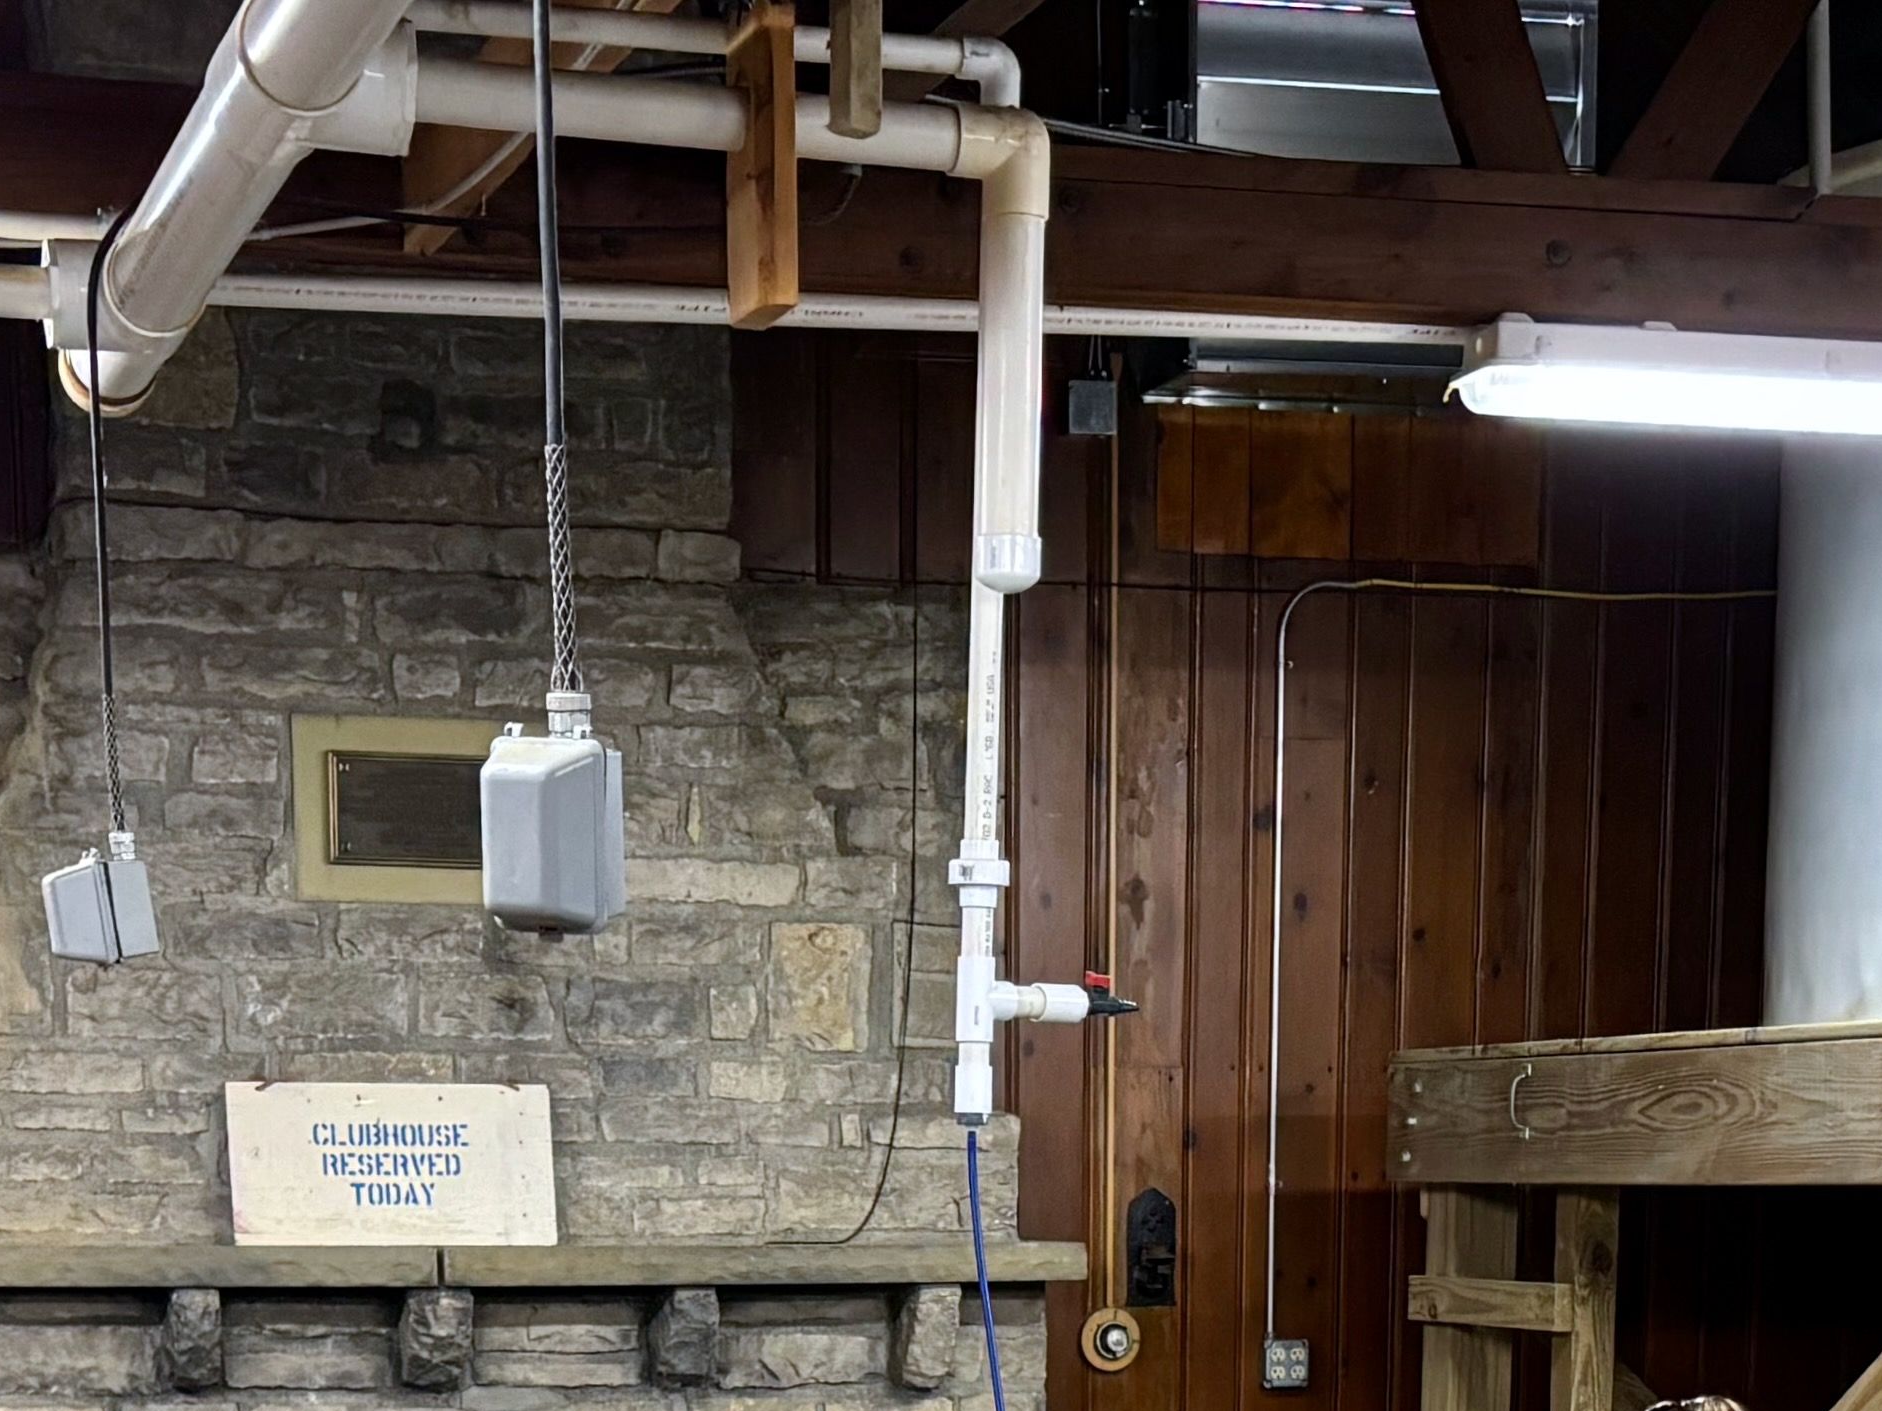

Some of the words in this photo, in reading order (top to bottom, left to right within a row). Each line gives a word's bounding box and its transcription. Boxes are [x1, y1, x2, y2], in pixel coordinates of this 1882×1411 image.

[312, 1122, 470, 1148] CLUBHOUSE
[322, 1152, 462, 1177] RESERVED
[349, 1181, 436, 1206] TODAY
